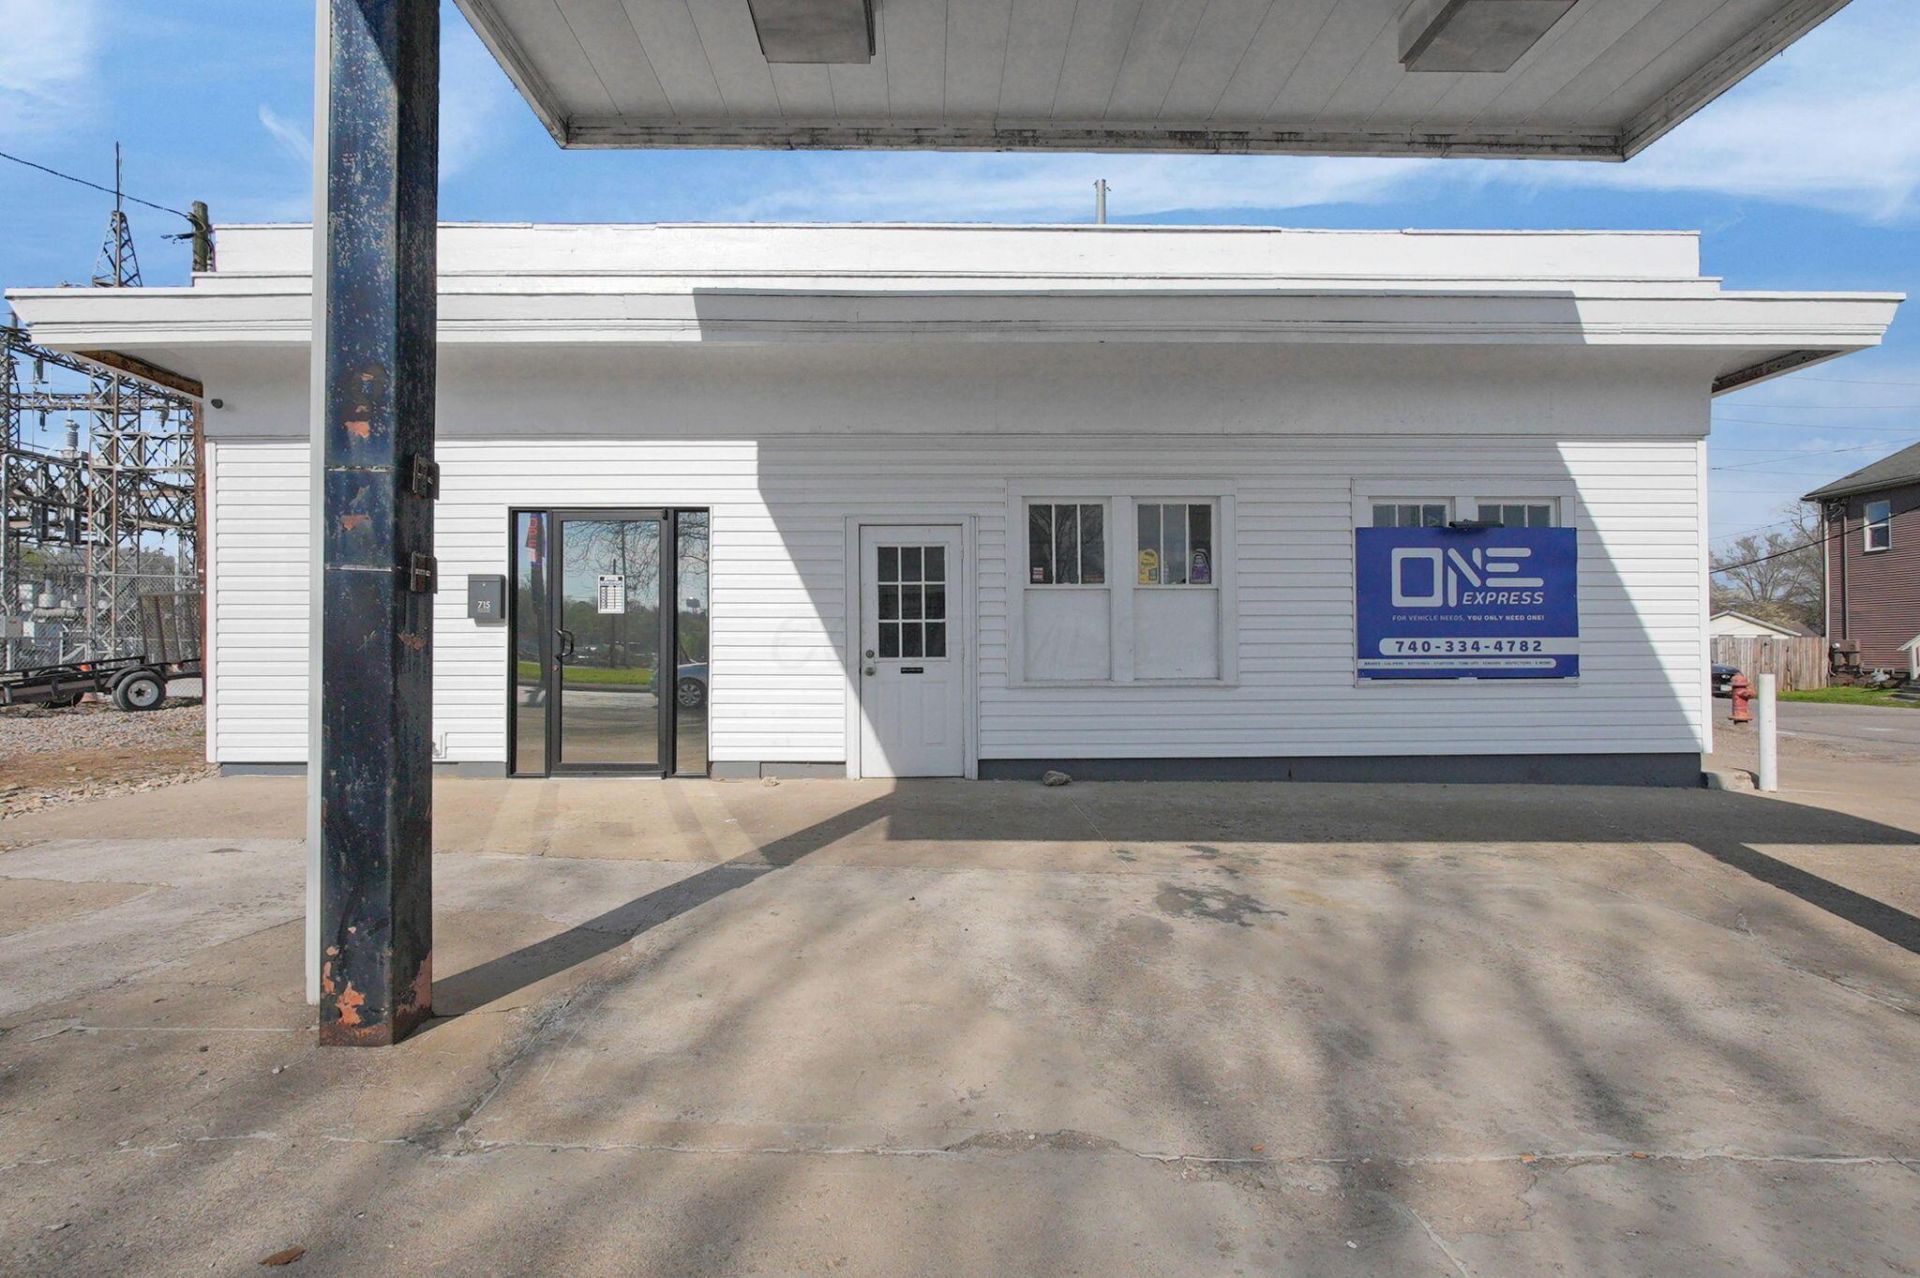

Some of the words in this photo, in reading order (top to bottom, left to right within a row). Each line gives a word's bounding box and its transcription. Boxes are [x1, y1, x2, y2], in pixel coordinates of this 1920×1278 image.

[1391, 547, 1544, 608] ONE
[477, 600, 491, 609] 715
[1462, 591, 1544, 605] EXPRESS
[1392, 614, 1407, 622] FOR
[1408, 614, 1438, 622] VEHICLE
[1467, 614, 1482, 622] YOU
[1484, 614, 1503, 622] ONLY
[1505, 614, 1525, 622] NEED
[1526, 614, 1545, 622] ONE!
[1395, 640, 1543, 653] 740-334-4782
